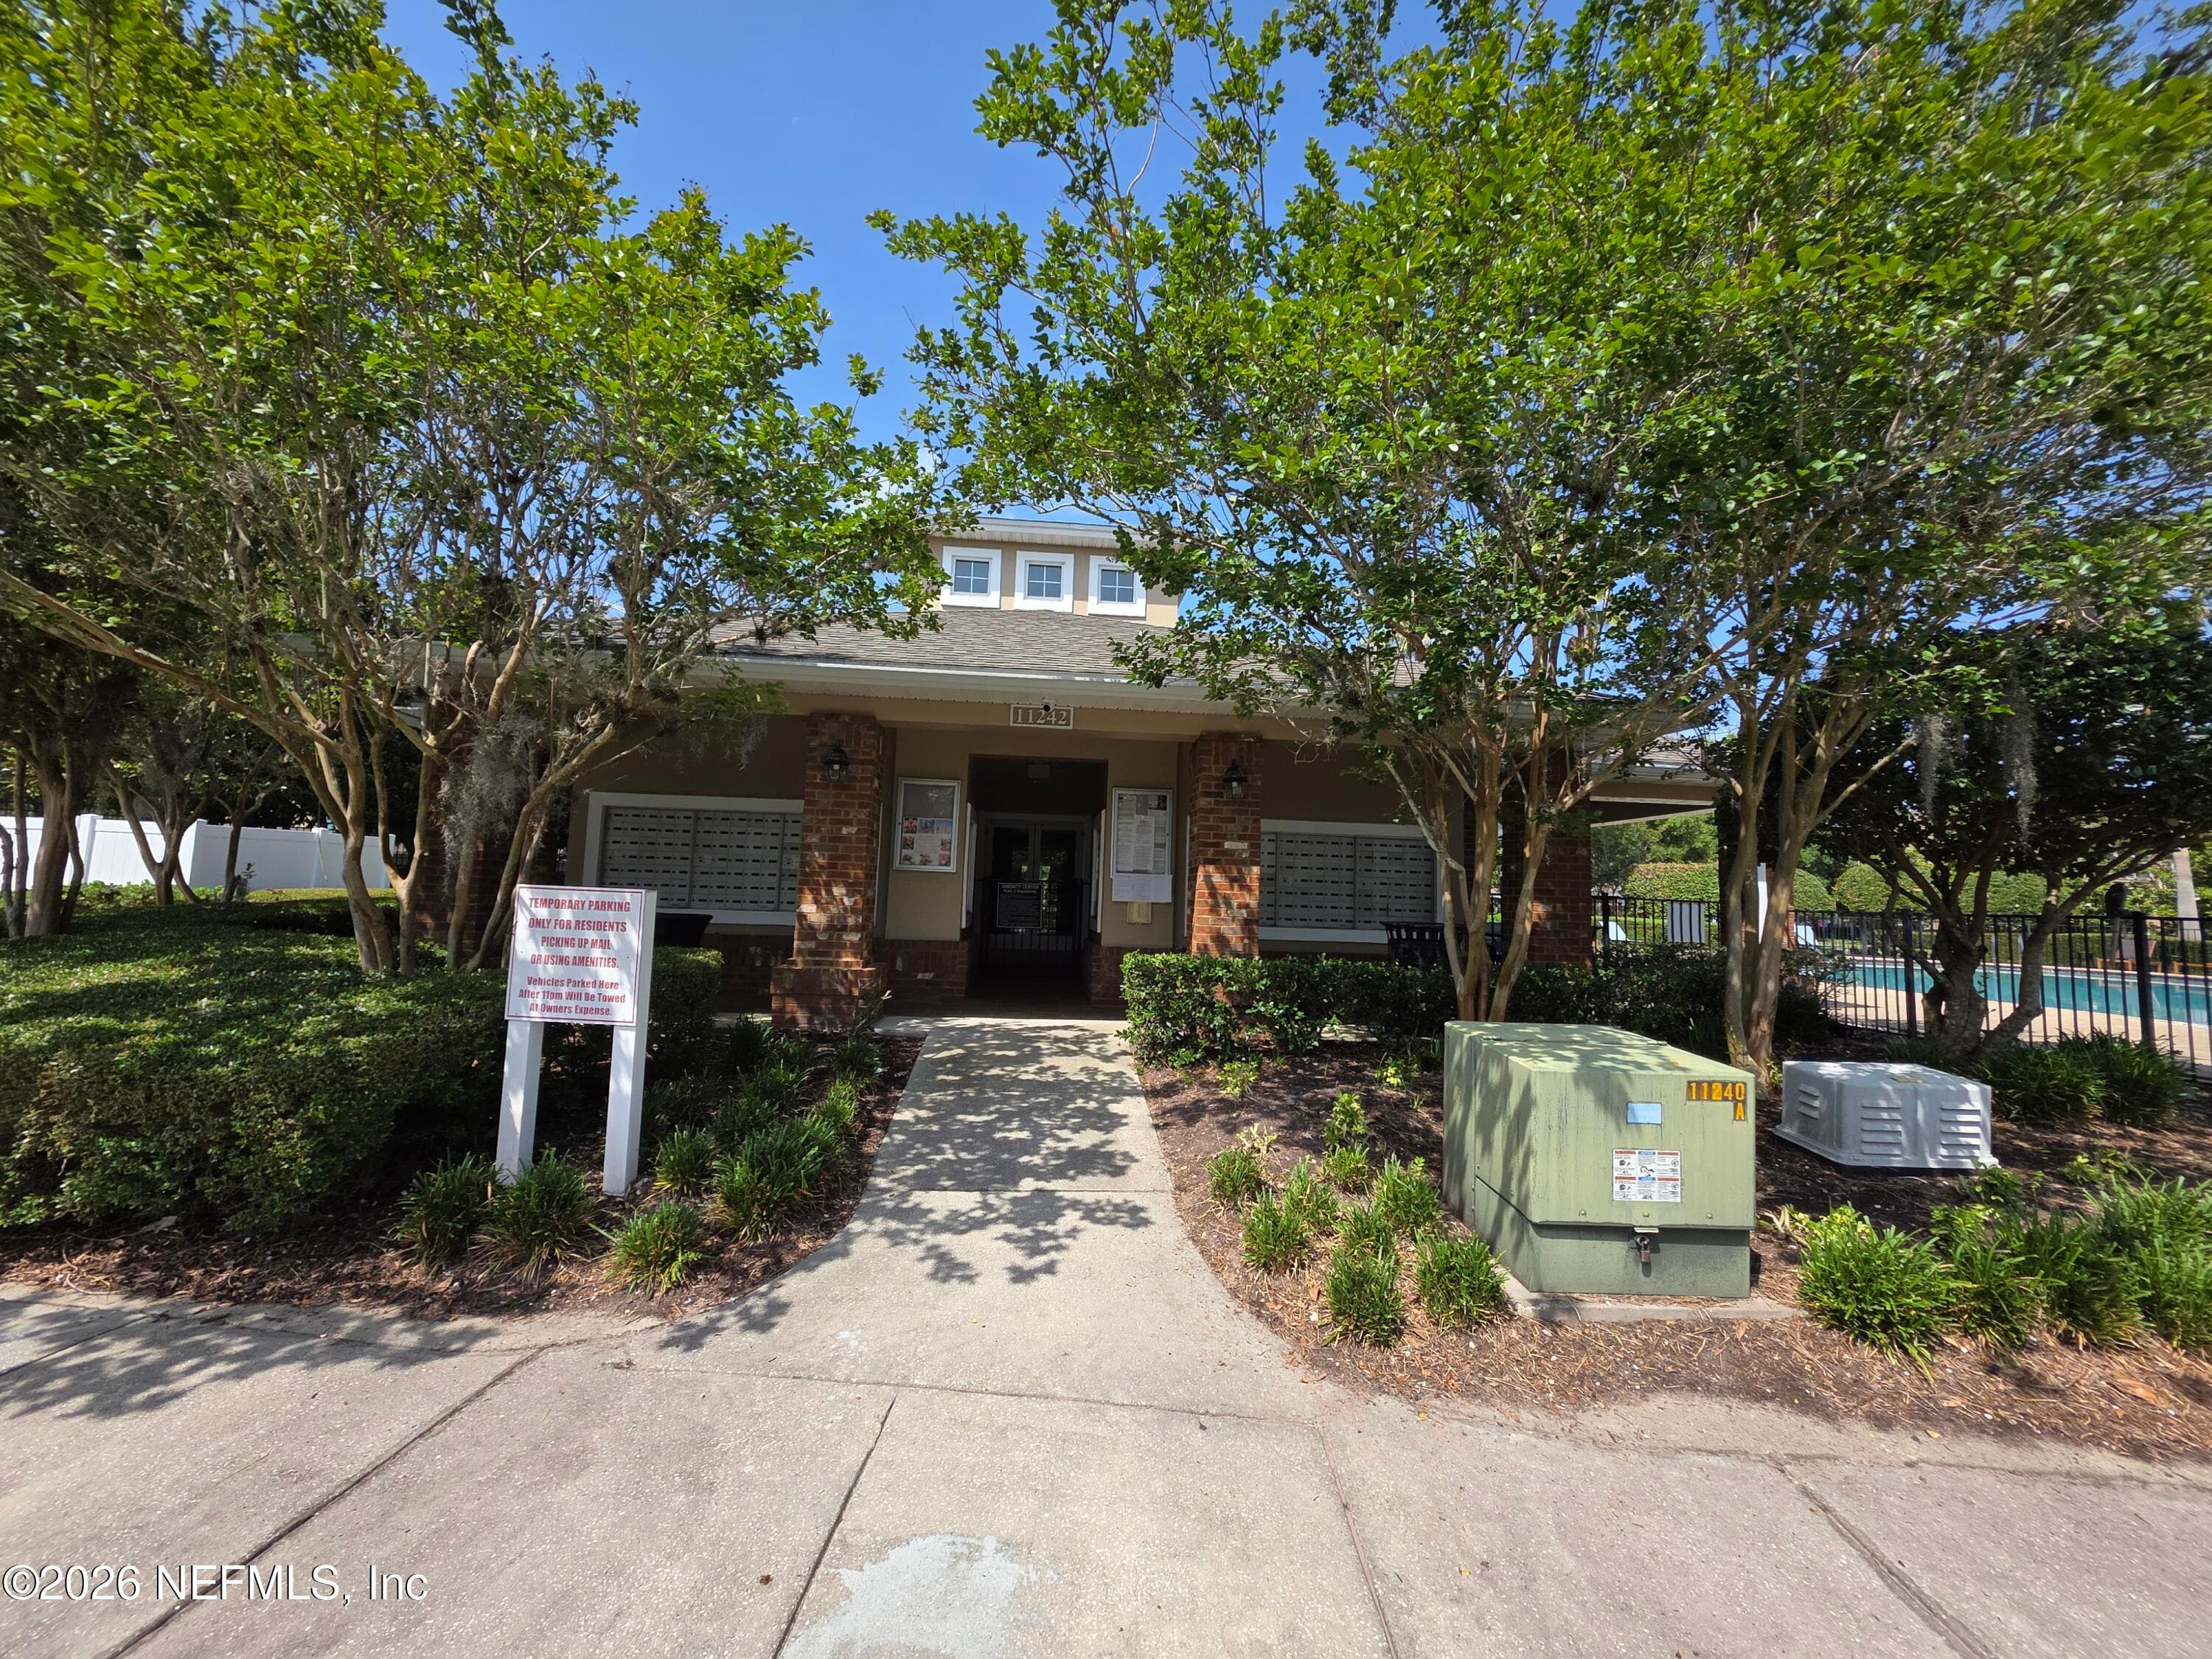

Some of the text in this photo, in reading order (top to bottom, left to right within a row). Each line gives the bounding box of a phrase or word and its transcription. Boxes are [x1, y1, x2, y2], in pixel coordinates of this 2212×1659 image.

[1016, 709, 1067, 725] 11242
[529, 897, 631, 912] TEMPORARY PARKING
[529, 918, 627, 932] ONLY FOR RESIDENTS
[541, 936, 611, 950] PICKING UP MAIL
[530, 954, 619, 968] OR USING AMENITIES.
[527, 976, 619, 990] Vehicles Parked Here
[518, 989, 626, 1004] After 11pm Will Be Towed
[529, 1003, 613, 1016] At Owners Expense.
[1736, 1102, 1745, 1120] A
